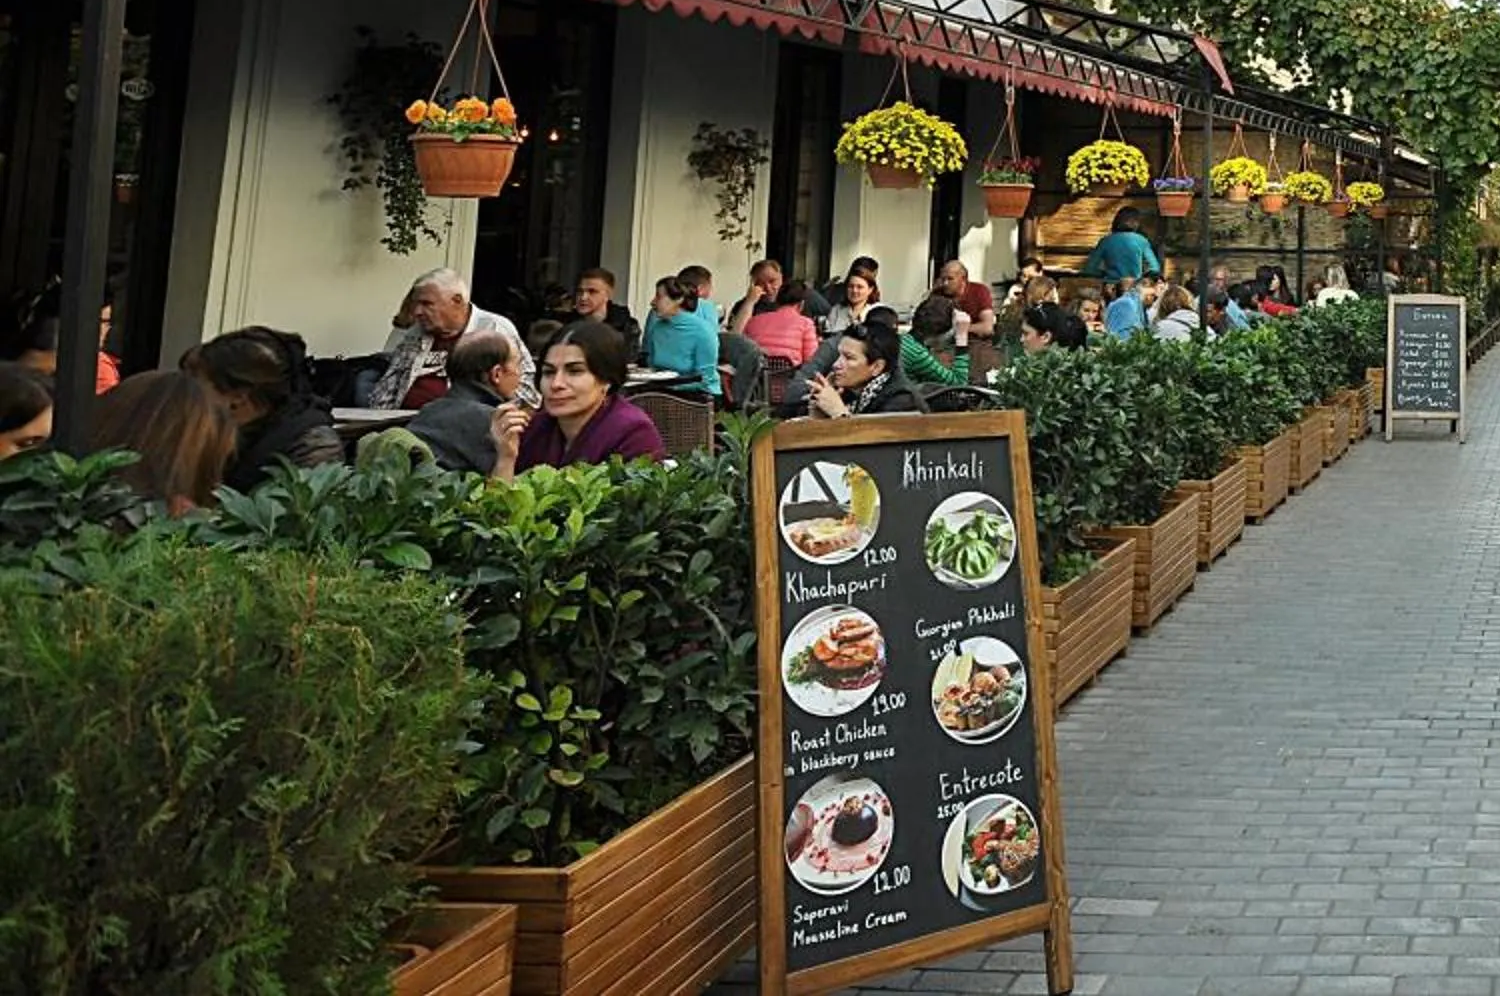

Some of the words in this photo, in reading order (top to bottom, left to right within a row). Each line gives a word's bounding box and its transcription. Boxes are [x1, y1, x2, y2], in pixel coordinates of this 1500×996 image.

[903, 449, 984, 489] Khinkali
[785, 568, 887, 605] Khachapuri
[791, 728, 831, 754] Roast
[835, 717, 888, 744] Chicken
[801, 752, 860, 774] blackberry
[863, 747, 896, 762] sauce
[939, 756, 1024, 801] Entrecote
[793, 899, 849, 927] Saperavi
[865, 911, 908, 929] Cream
